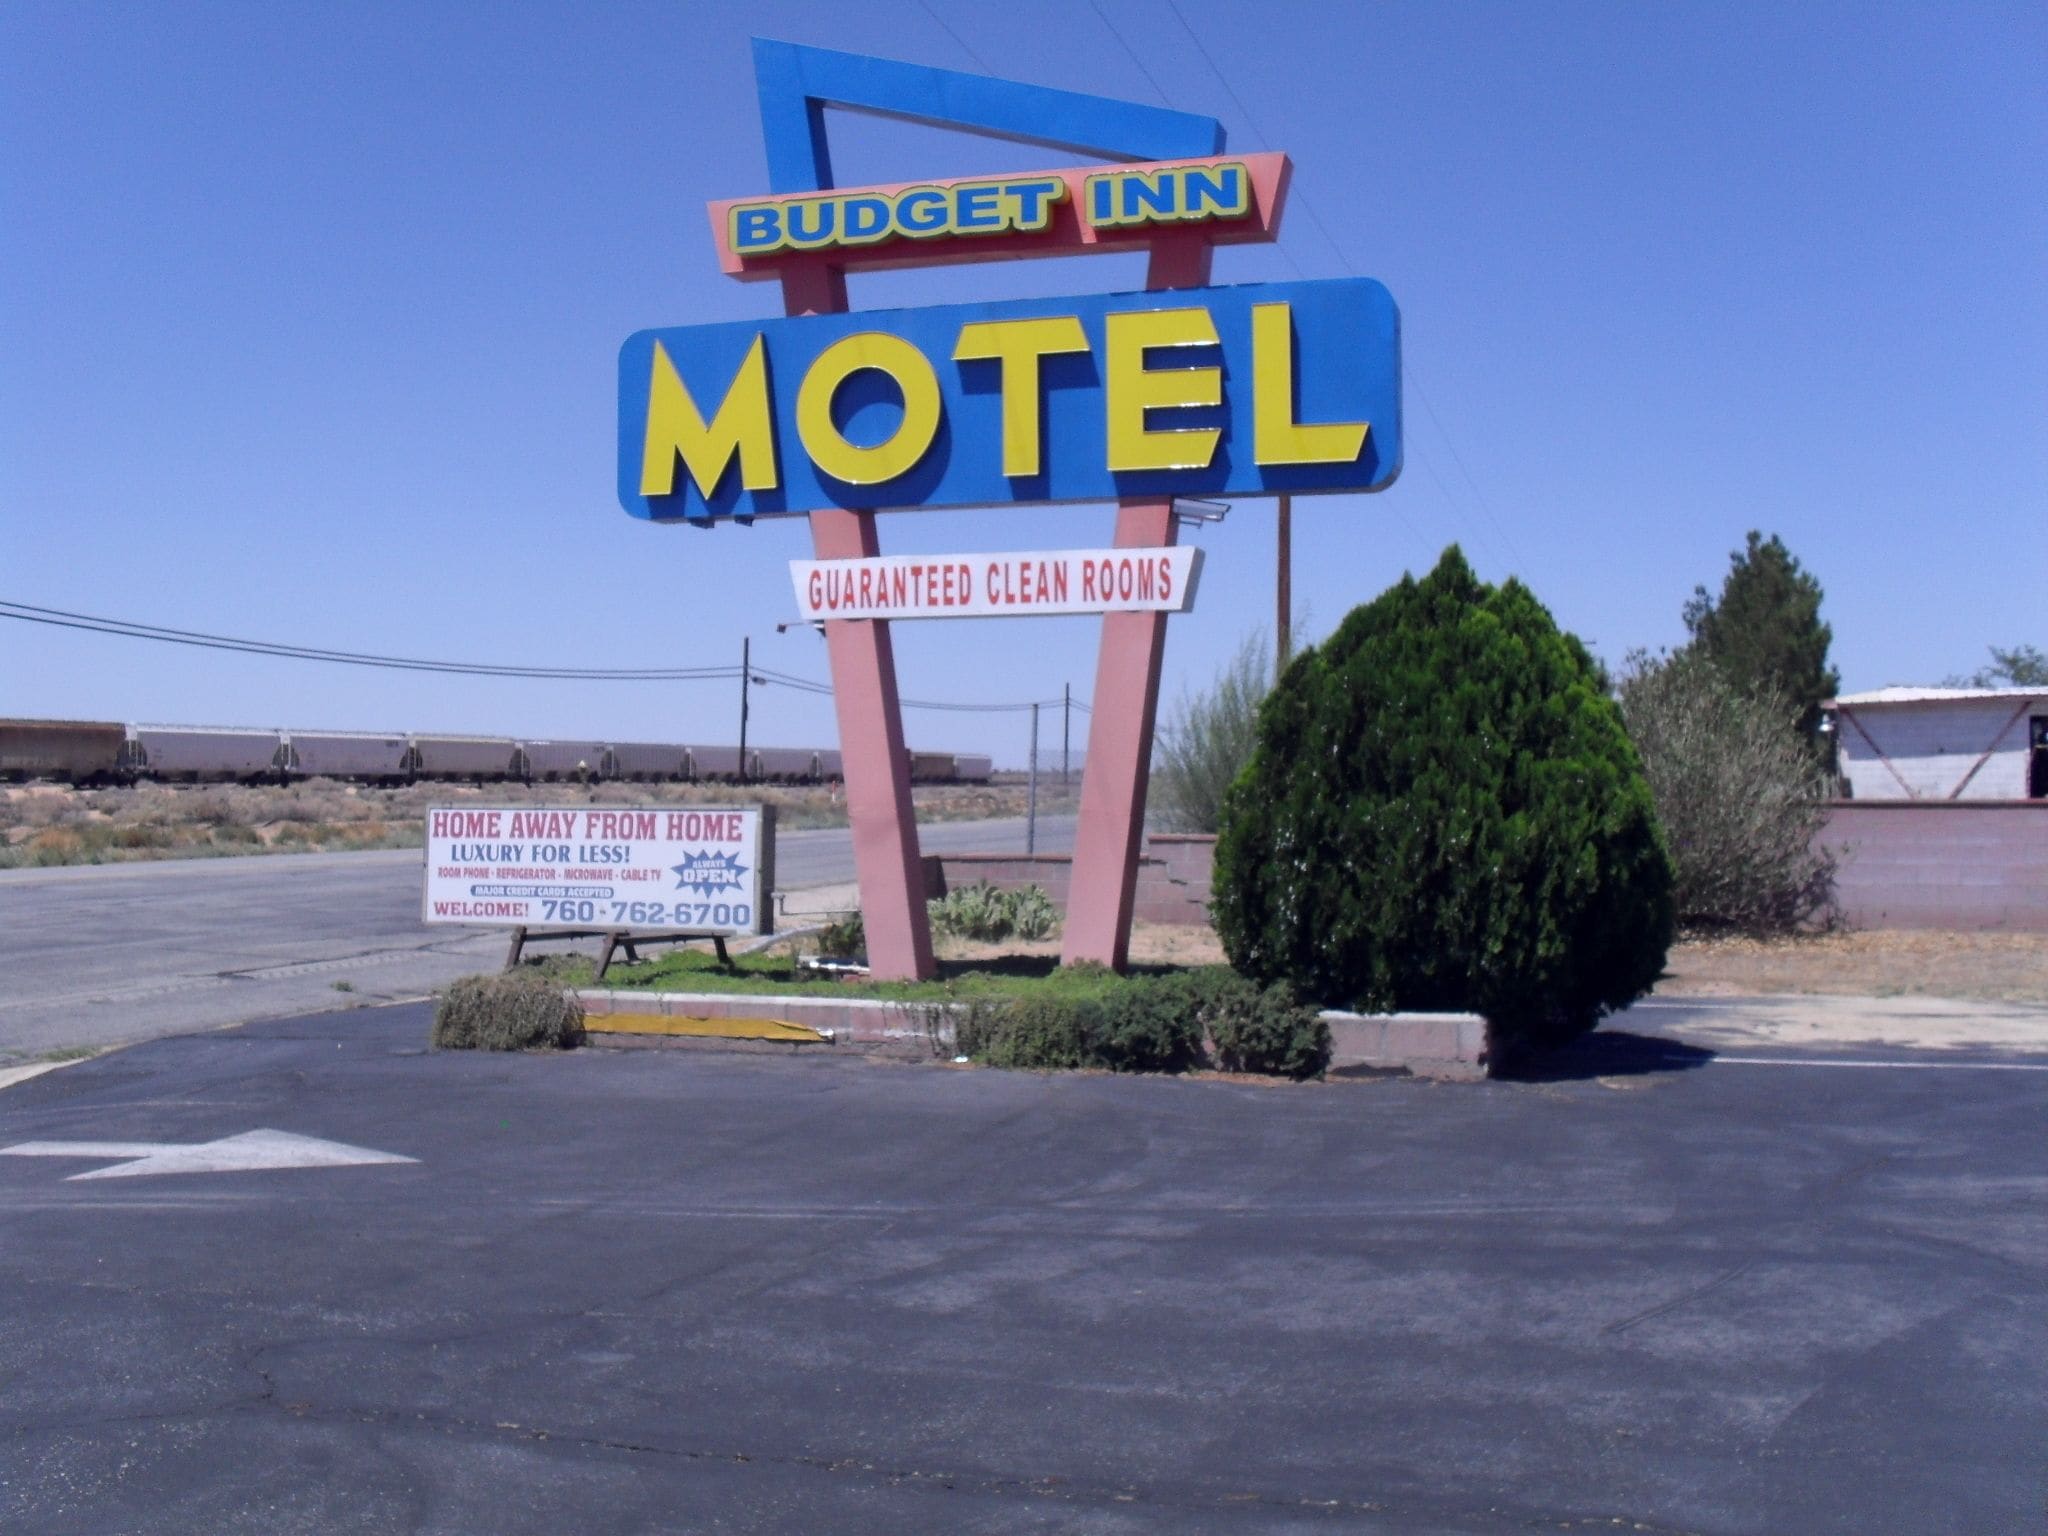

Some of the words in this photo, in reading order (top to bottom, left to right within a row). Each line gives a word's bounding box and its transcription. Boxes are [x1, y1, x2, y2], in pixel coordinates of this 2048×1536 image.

[733, 178, 1059, 252] BUDGET
[1090, 165, 1245, 222] INN
[639, 302, 1370, 500] MOTEL
[808, 564, 972, 612] GUARANTEED
[986, 561, 1068, 606] CLEAN
[1081, 557, 1172, 602] ROOMS
[432, 811, 502, 839] HOME
[509, 811, 577, 840] AWAY
[585, 812, 657, 841] FROM
[665, 813, 743, 842] HOME
[451, 844, 524, 863] LUXURY
[531, 844, 571, 863] FOR
[579, 844, 631, 864] LESS!
[692, 859, 726, 869] ALWAYS
[437, 866, 461, 879] ROOM
[463, 866, 490, 880] PHONE
[496, 867, 556, 881] REFRIGERATOR
[563, 868, 613, 882] MICROWAVE
[620, 868, 649, 882] CABLE
[650, 868, 661, 882] TV
[682, 867, 736, 884] OPEN
[474, 885, 503, 897] MAJOR
[505, 886, 536, 897] CREDIT
[537, 886, 566, 898] CARDS
[567, 886, 613, 899] ACCEPTED
[433, 901, 529, 918] WELCOME!
